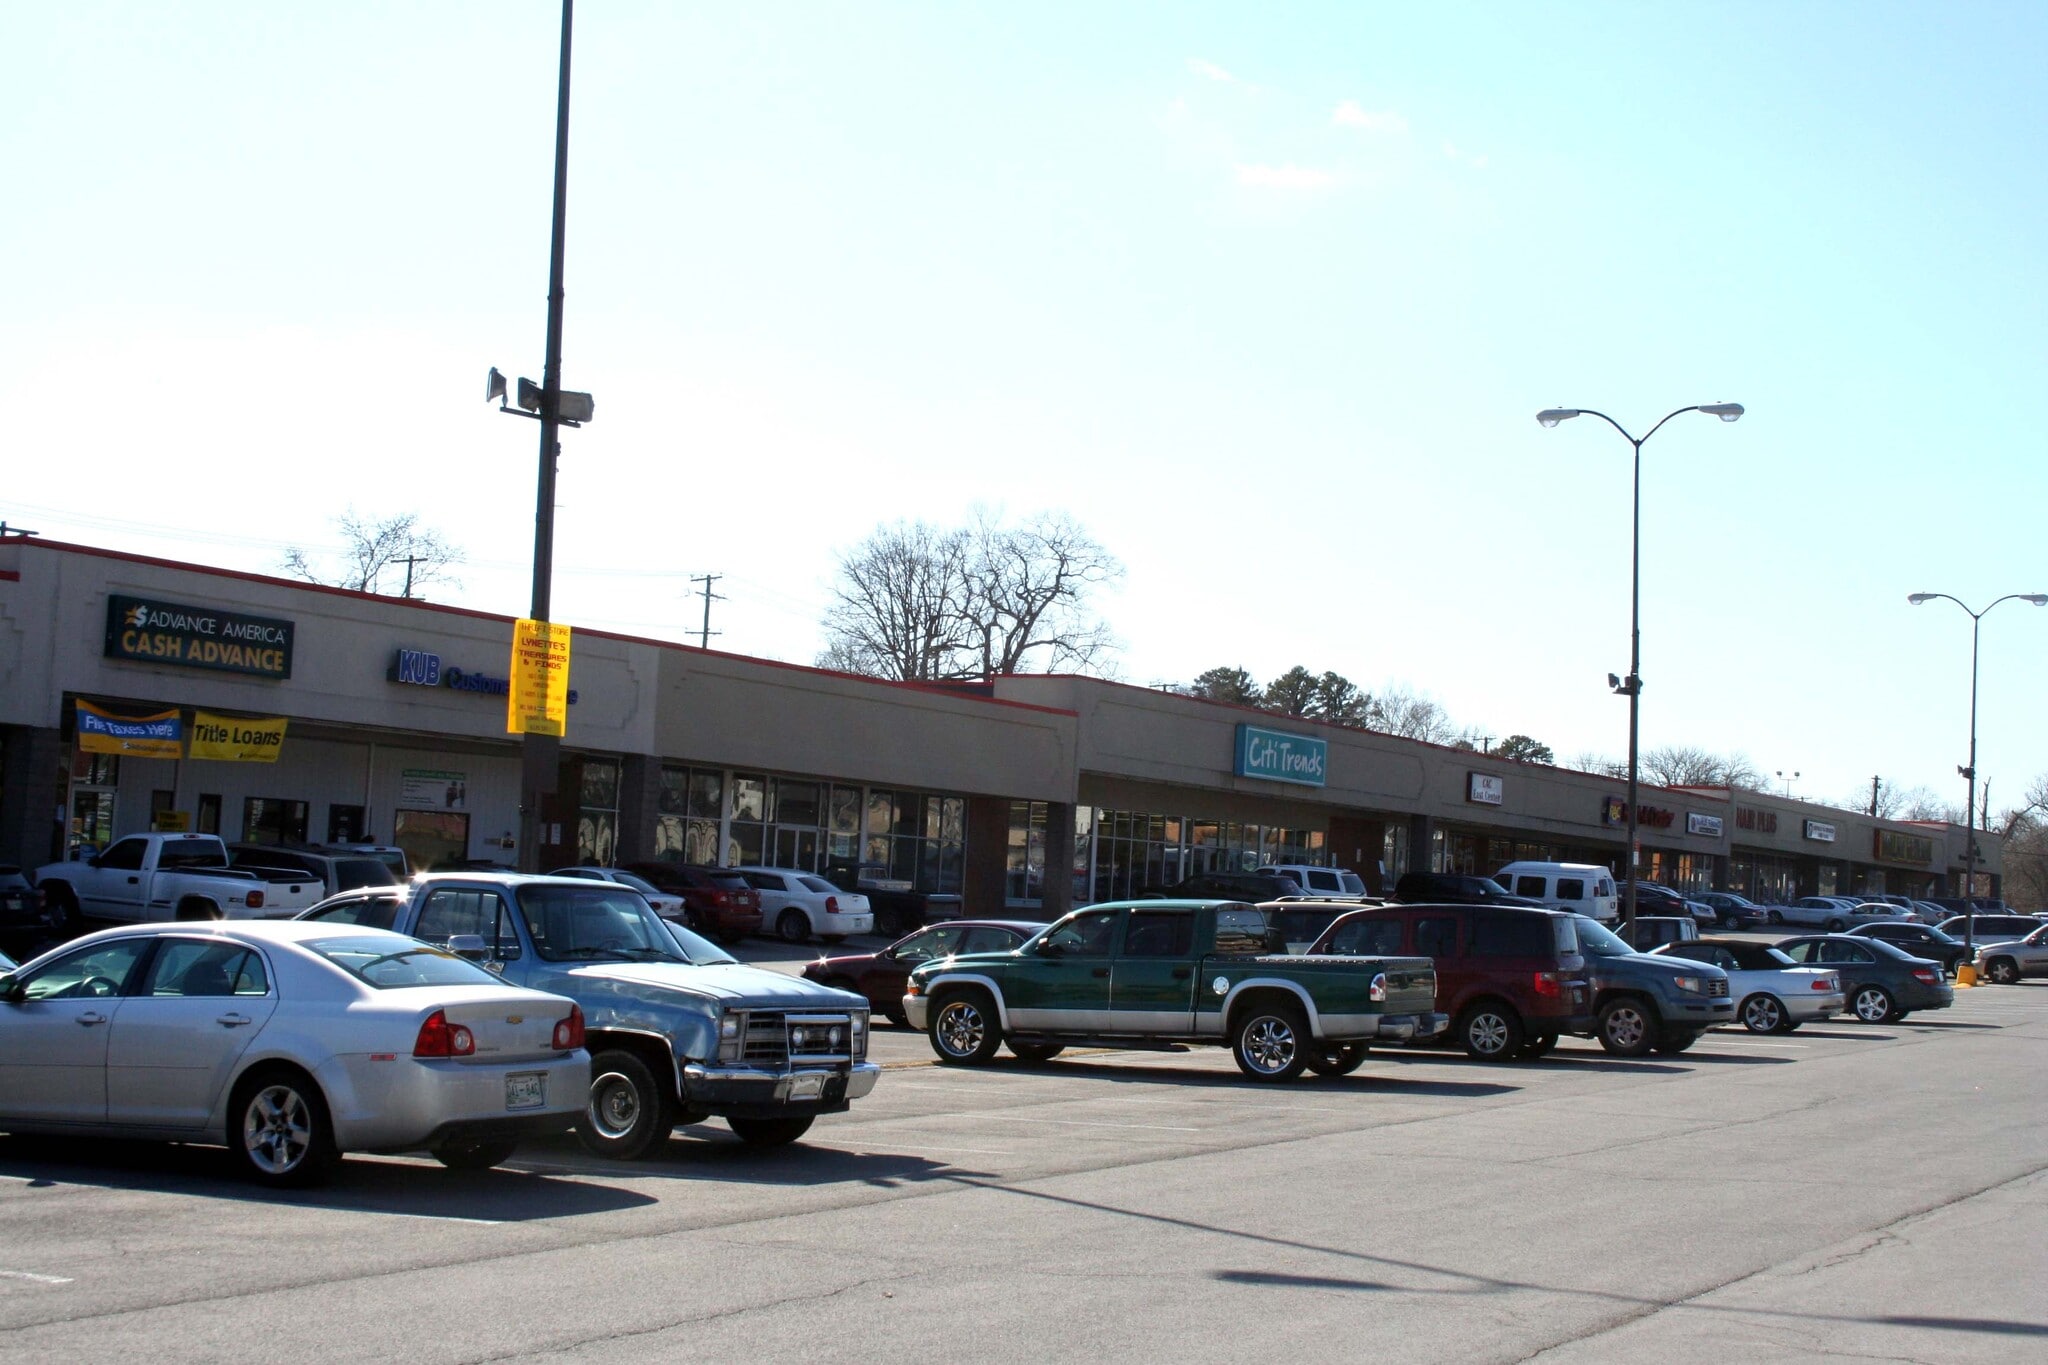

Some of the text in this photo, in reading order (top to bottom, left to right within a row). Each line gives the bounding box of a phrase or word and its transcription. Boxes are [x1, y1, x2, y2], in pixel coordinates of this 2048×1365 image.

[147, 613, 285, 644] ADVANCE AMERICA
[122, 630, 284, 672] CASH ADVANCE
[519, 649, 567, 662] TREASURES
[521, 637, 566, 651] LYNETTE'S
[399, 649, 441, 686] KUB
[535, 660, 562, 670] FINDS
[107, 721, 146, 737] Taxes
[149, 723, 174, 738] Here
[195, 724, 282, 747] Title Loans
[1250, 737, 1323, 777] Citi Trends
[1736, 807, 1755, 830] HAIR
[1757, 810, 1777, 833] PLUS
